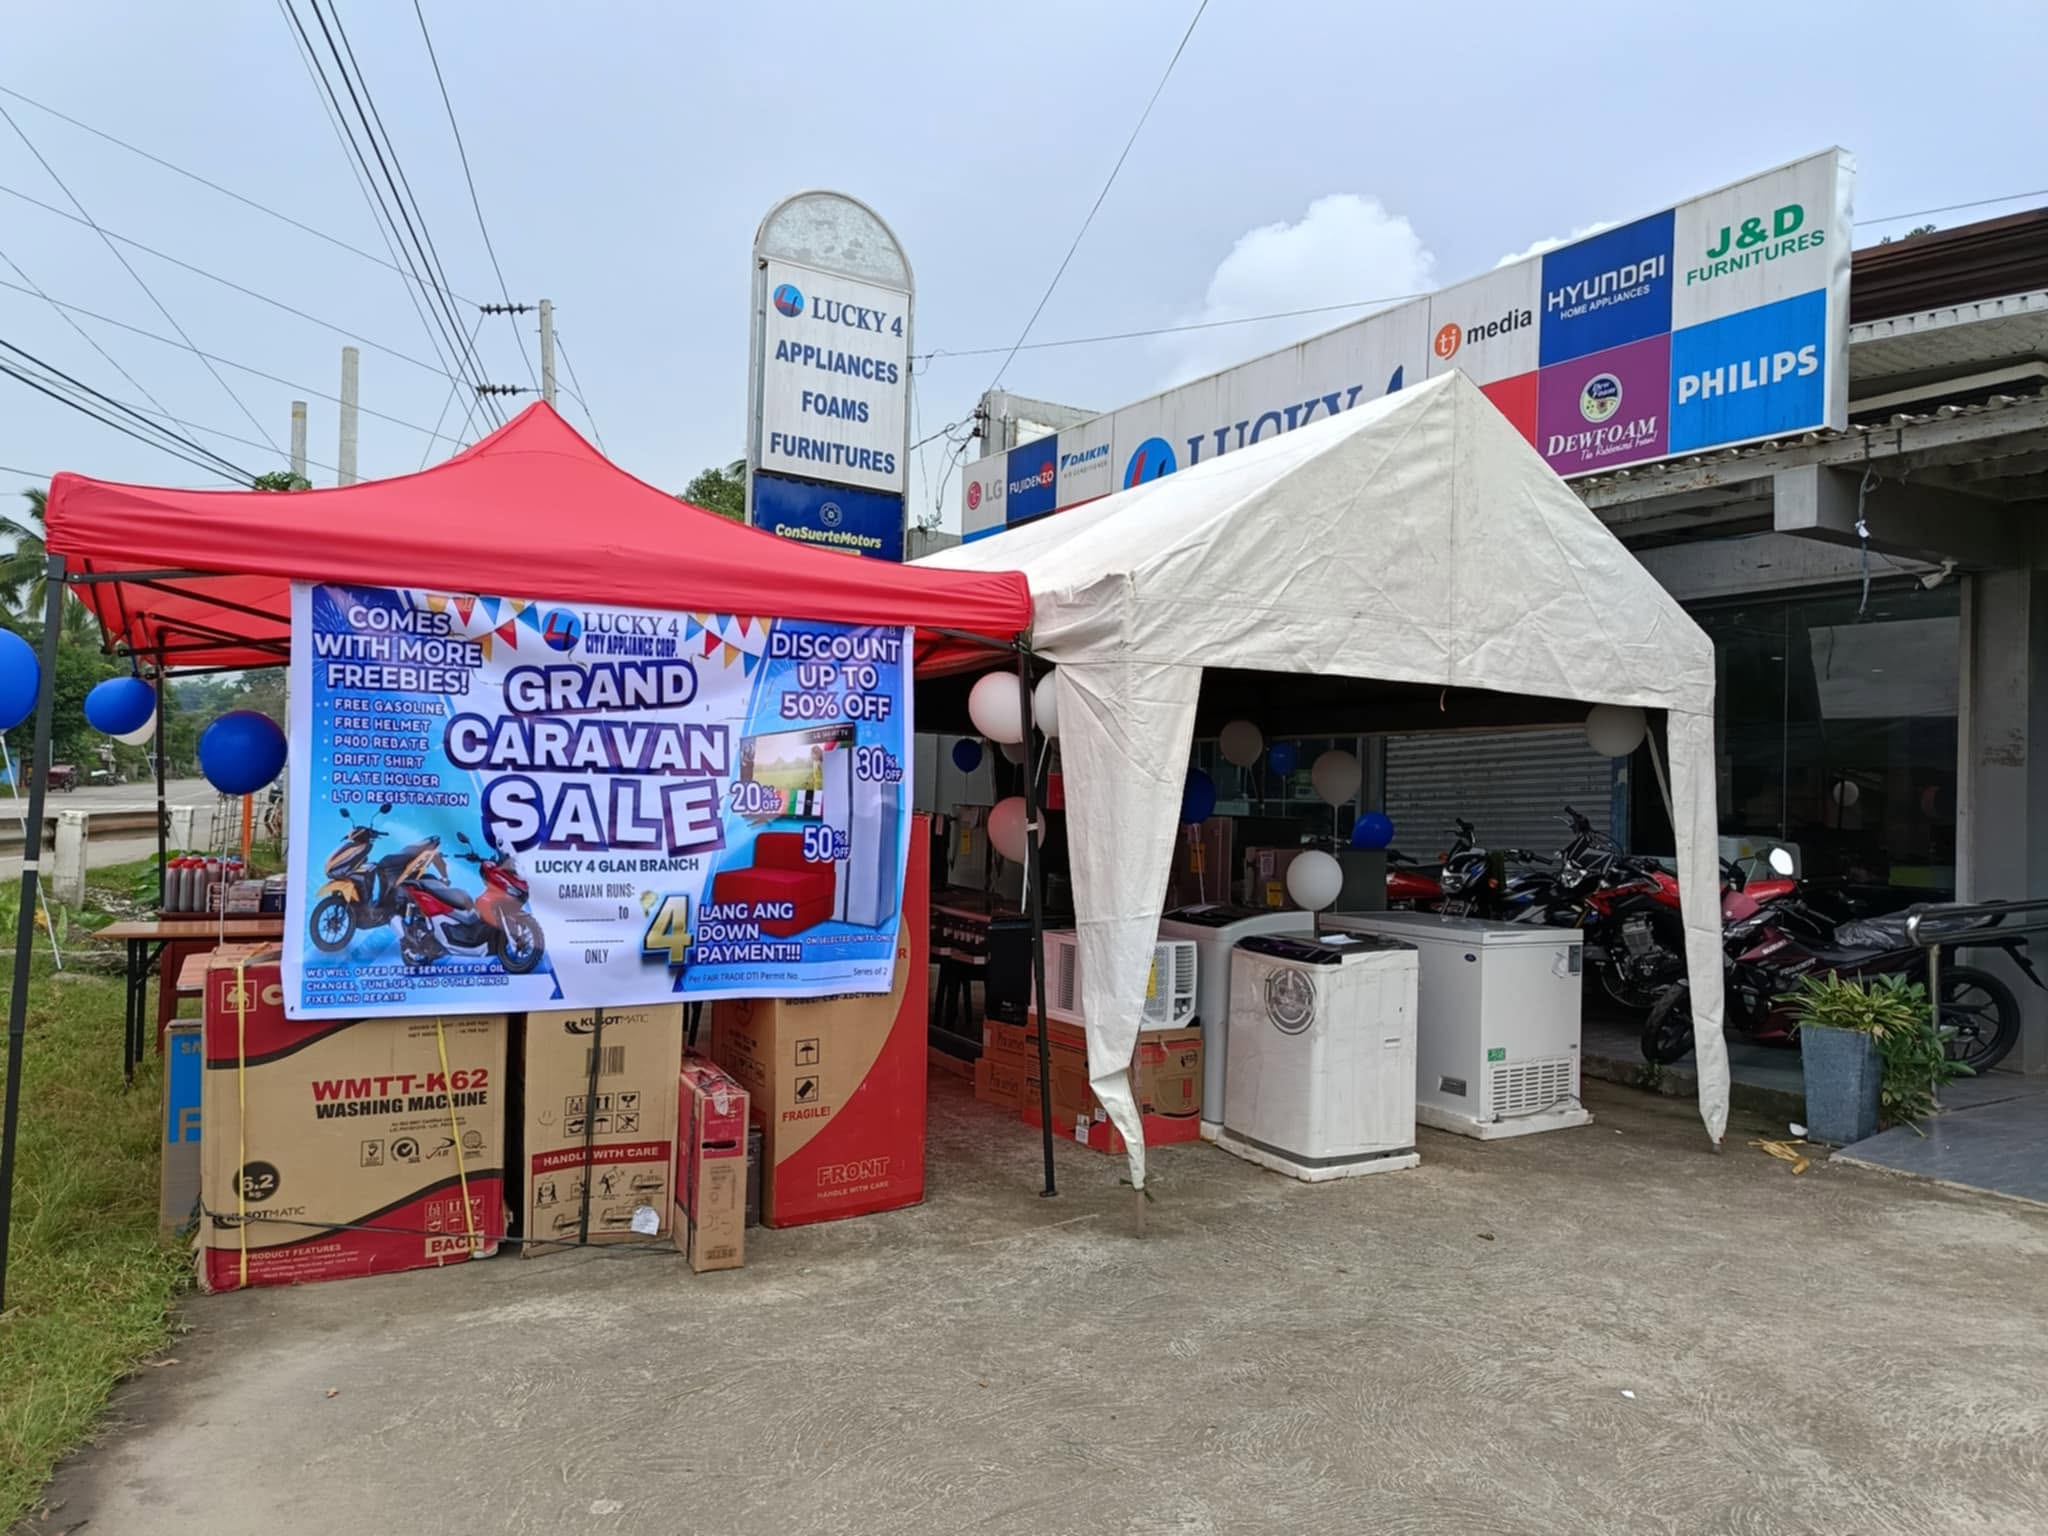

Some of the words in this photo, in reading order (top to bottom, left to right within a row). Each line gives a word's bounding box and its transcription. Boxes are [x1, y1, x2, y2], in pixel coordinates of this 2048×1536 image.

[1707, 204, 1804, 259] J&D
[1688, 230, 1824, 286] FURNITURES
[1548, 255, 1664, 312] HYUNDAI
[1561, 306, 1587, 320] HOME
[1589, 285, 1650, 311] APPLIANCES
[812, 297, 887, 333] LUCKY
[891, 316, 903, 337] 4
[1467, 309, 1532, 344] media
[775, 340, 898, 384] APPLIANCES
[1679, 344, 1818, 404] PHILIPS
[802, 390, 869, 423] FOAMS
[1547, 416, 1657, 456] DEWFOAM
[771, 432, 895, 474] FURNITURES
[1071, 444, 1109, 467] DAIKIN
[986, 480, 1002, 501] LG
[1009, 470, 1053, 494] FUJIDENZO
[776, 524, 882, 548] ConSuerteMotors
[348, 606, 450, 635] COMES
[583, 613, 661, 635] LUCKY
[668, 619, 678, 637] 4
[315, 634, 389, 659] WITH
[400, 638, 482, 666] MORE
[585, 634, 604, 654] CITY
[607, 636, 653, 656] APPLIANCE
[771, 632, 900, 662] DISCOUNT
[328, 664, 469, 694] FREEBIES!
[506, 662, 695, 715] GRAND
[799, 666, 835, 688] UP
[843, 667, 877, 689] TO
[334, 699, 369, 711] FREE
[374, 701, 444, 715] GASOLINE
[782, 694, 837, 718] 50%
[844, 696, 890, 720] OFF
[334, 717, 369, 729] FREE
[374, 719, 431, 733] HELMET
[334, 736, 368, 748] P400
[373, 737, 428, 751] REBATE
[446, 715, 728, 775] CARAVAN
[334, 754, 378, 767] DRIFIT
[384, 756, 425, 768] SHIRT
[333, 772, 379, 785] PLATE
[384, 774, 439, 787] HOLDER
[885, 770, 901, 780] OFF
[333, 790, 361, 803] LTO
[367, 791, 469, 806] REGISTRATION
[762, 801, 780, 809] OFF
[486, 779, 723, 854] SALE
[834, 848, 849, 857] OFF
[535, 860, 583, 873] LUCKY
[586, 860, 595, 872] 4
[598, 859, 637, 872] GLAN
[641, 859, 699, 871] BRANCH
[559, 884, 603, 899] CARAVAN
[607, 884, 635, 897] RUNS:
[619, 904, 629, 920] to
[700, 904, 749, 920] LANG
[753, 902, 793, 919] ANG
[645, 895, 692, 962] 4
[698, 924, 759, 941] DOWN
[585, 949, 609, 964] ONLY
[697, 944, 800, 963] PAYMENT!!!
[307, 968, 323, 978] WE
[326, 967, 350, 977] WILL
[355, 967, 386, 976] OFFER
[390, 966, 415, 976] FREE
[418, 965, 466, 975] SERVICES
[467, 965, 486, 974] FOR
[489, 964, 505, 973] OIL
[761, 972, 786, 980] Permit
[853, 968, 872, 976] Series
[875, 967, 882, 975] of
[307, 981, 357, 992] CHANGES,
[418, 978, 439, 987] AND
[442, 977, 476, 987] OTHER
[478, 976, 509, 986] MINOR
[306, 995, 335, 1004] FIXES
[338, 994, 360, 1003] AND
[364, 992, 407, 1003] REPAIRS
[312, 1069, 489, 1101] WMTT-K62
[316, 1099, 402, 1119] WASHING
[408, 1091, 488, 1113] MACHINE
[782, 1106, 831, 1122] FRAGILE!
[543, 1154, 588, 1167] HANDL
[593, 1149, 625, 1159] WITH
[627, 1146, 658, 1158] CARE
[817, 1158, 889, 1186] FRONT
[817, 1188, 848, 1199] HANDLE
[851, 1184, 869, 1194] WITH
[871, 1181, 889, 1191] CARE
[293, 1244, 341, 1256] FEATURES
